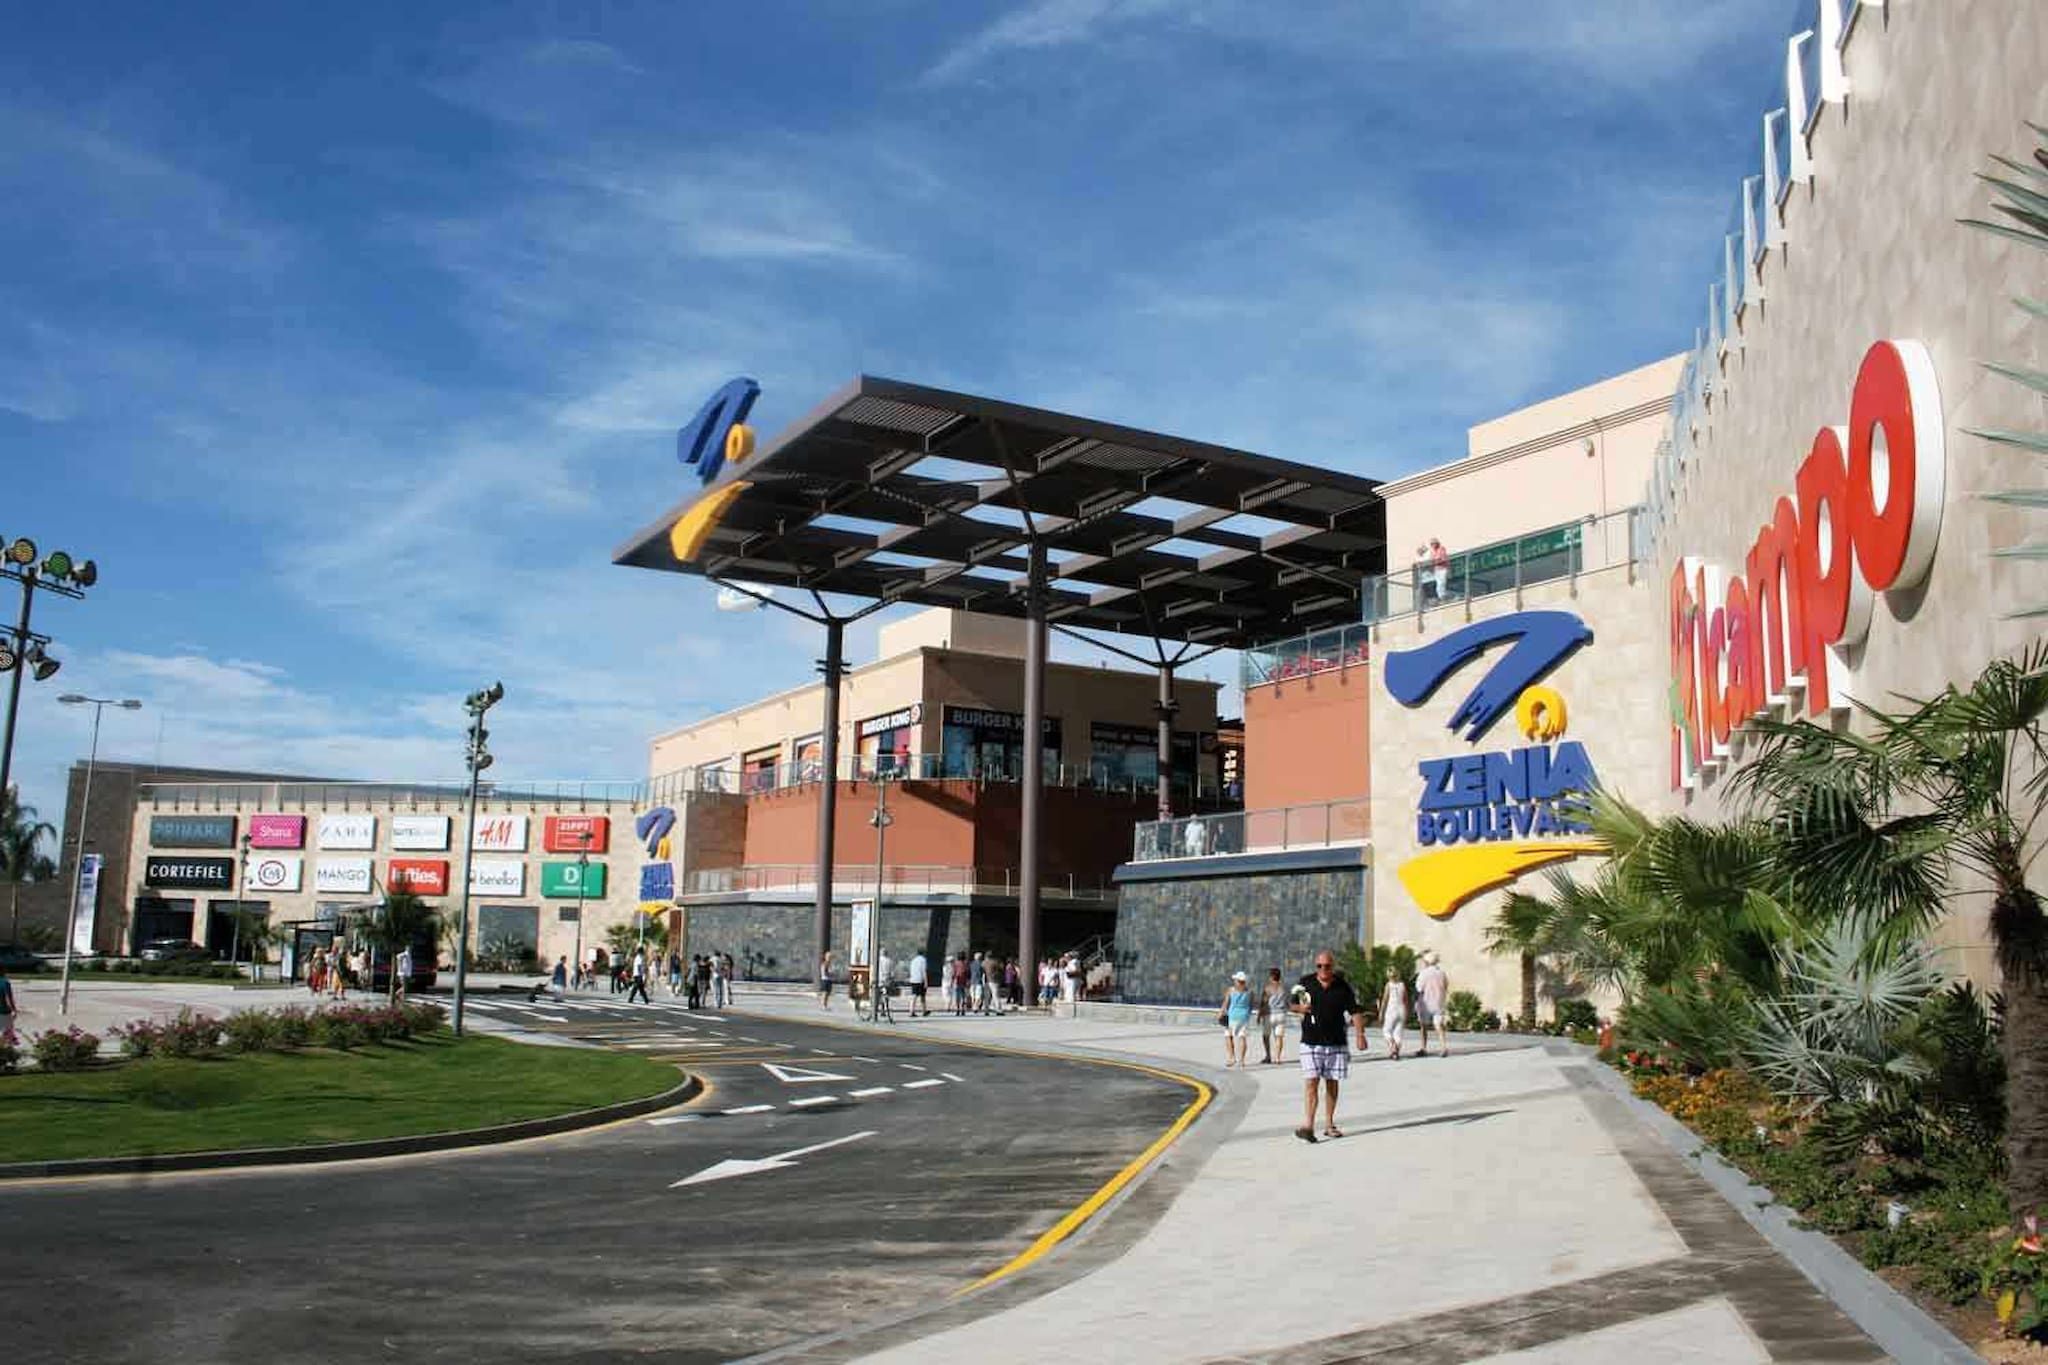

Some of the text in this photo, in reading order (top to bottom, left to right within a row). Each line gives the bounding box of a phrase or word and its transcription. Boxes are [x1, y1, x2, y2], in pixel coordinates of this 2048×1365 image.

[862, 715, 889, 736] BURGER
[891, 710, 910, 728] KING
[953, 710, 1051, 733] BURGER KG
[1418, 741, 1602, 808] ZENIA
[153, 822, 229, 838] PRIMARK
[260, 825, 292, 838] Shana
[150, 863, 225, 879] CORTEFIEL
[318, 868, 366, 881] MANGO
